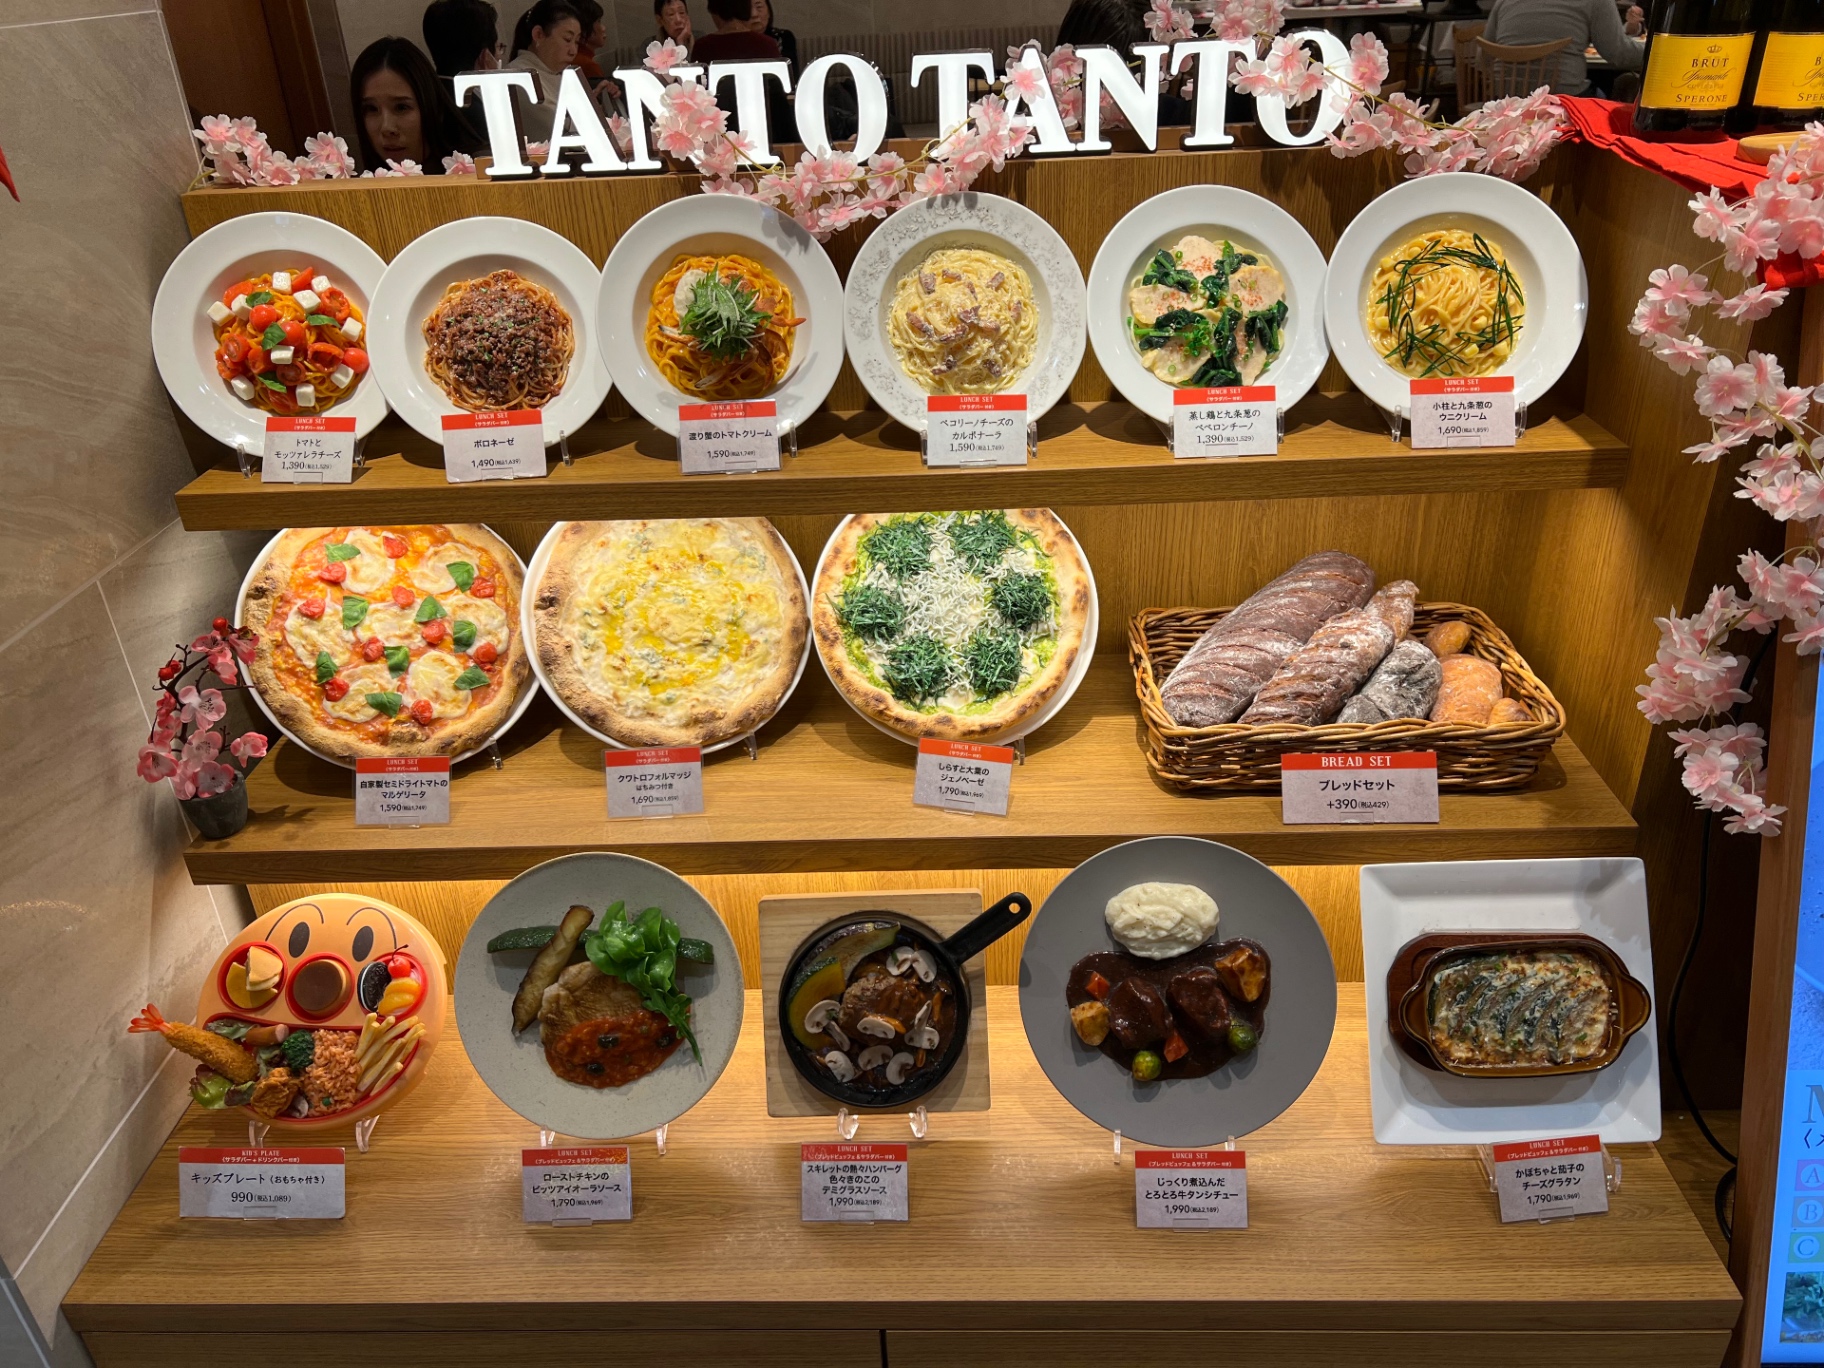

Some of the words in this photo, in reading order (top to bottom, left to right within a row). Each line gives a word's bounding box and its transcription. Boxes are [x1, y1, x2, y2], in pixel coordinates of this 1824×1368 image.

[1692, 58, 1729, 67] BRUT
[453, 52, 888, 176] TANTO
[909, 28, 1353, 156] TANTO
[1676, 93, 1727, 102] SPERONE
[475, 412, 495, 420] LUNCH
[1439, 412, 1487, 421] ウニクリーム
[688, 429, 772, 440] 渡り蟹のトマトクリーム
[952, 431, 1002, 440] カルボナーラ
[296, 438, 322, 447] トマトと
[473, 437, 515, 448] ボロネーゼ
[274, 451, 342, 459] モッツァレラチーズ
[950, 743, 969, 751] LUNCH
[1321, 756, 1363, 767] BREAD
[1369, 756, 1392, 767] SET
[938, 763, 990, 776] しらすと大葉の
[617, 771, 692, 783] クワトロフォルマッジ
[940, 773, 985, 787] ジェノベーゼ
[360, 780, 448, 789] 自家製セミドライトマトの
[635, 783, 674, 791] はちみつ付き
[1319, 779, 1395, 791] ブレッドセット
[381, 790, 426, 799] マルゲリータ
[1529, 1141, 1551, 1149] LUNCH
[1552, 1139, 1565, 1147] SET
[807, 1164, 902, 1174] スキレットの熱々ハンバーグ
[1515, 1163, 1585, 1179] かぼちゃと茄子の
[543, 1172, 609, 1181] ローストチキンの
[829, 1175, 880, 1184] 色々きのこの
[1804, 1167, 1821, 1184] A
[1157, 1177, 1225, 1187] じっくり煮込んだ
[1522, 1177, 1581, 1191] チーズグラタン
[822, 1186, 887, 1195] デミグラスソース
[1145, 1190, 1239, 1200] とろとろ牛タンシチュー
[1804, 1204, 1818, 1221] B
[1797, 1239, 1815, 1256] C
